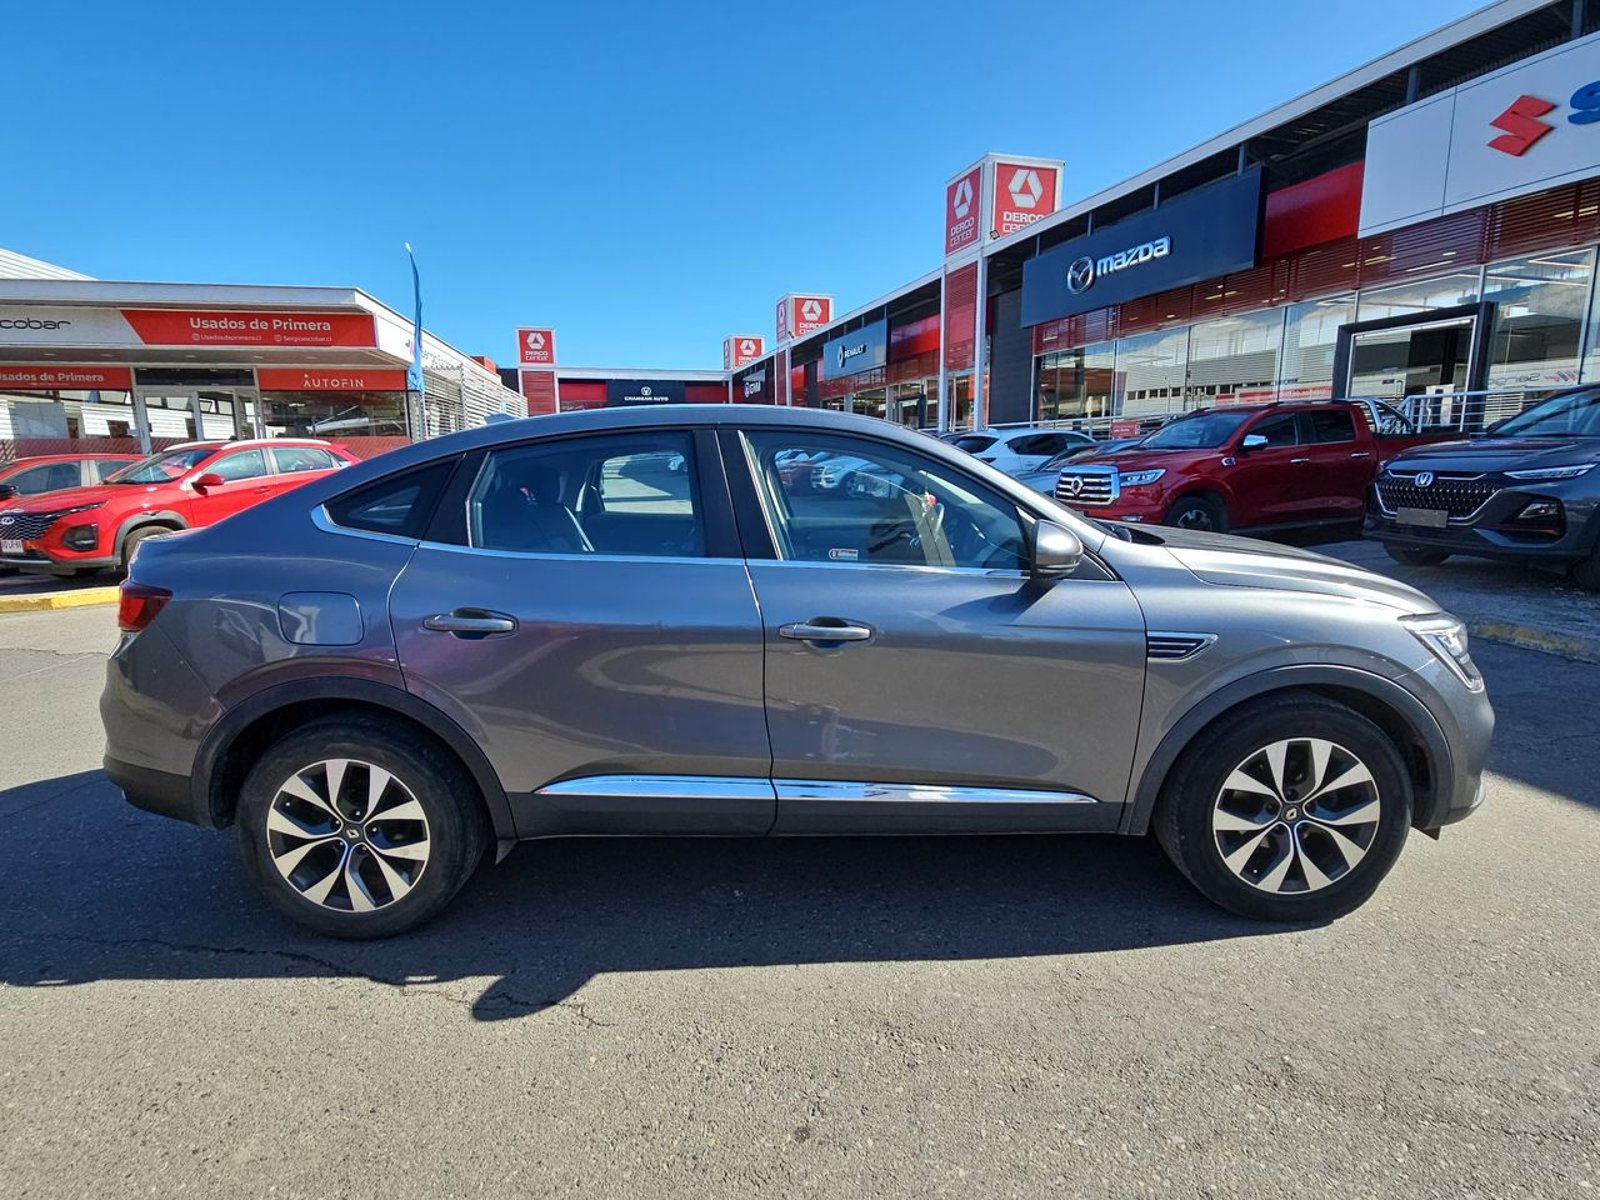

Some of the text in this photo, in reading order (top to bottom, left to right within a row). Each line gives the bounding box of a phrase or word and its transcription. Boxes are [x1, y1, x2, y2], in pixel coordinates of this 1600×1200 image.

[190, 317, 331, 331] Usados de Primera
[0, 372, 104, 382] sados de Primera
[303, 375, 365, 388] AUTOFIN
